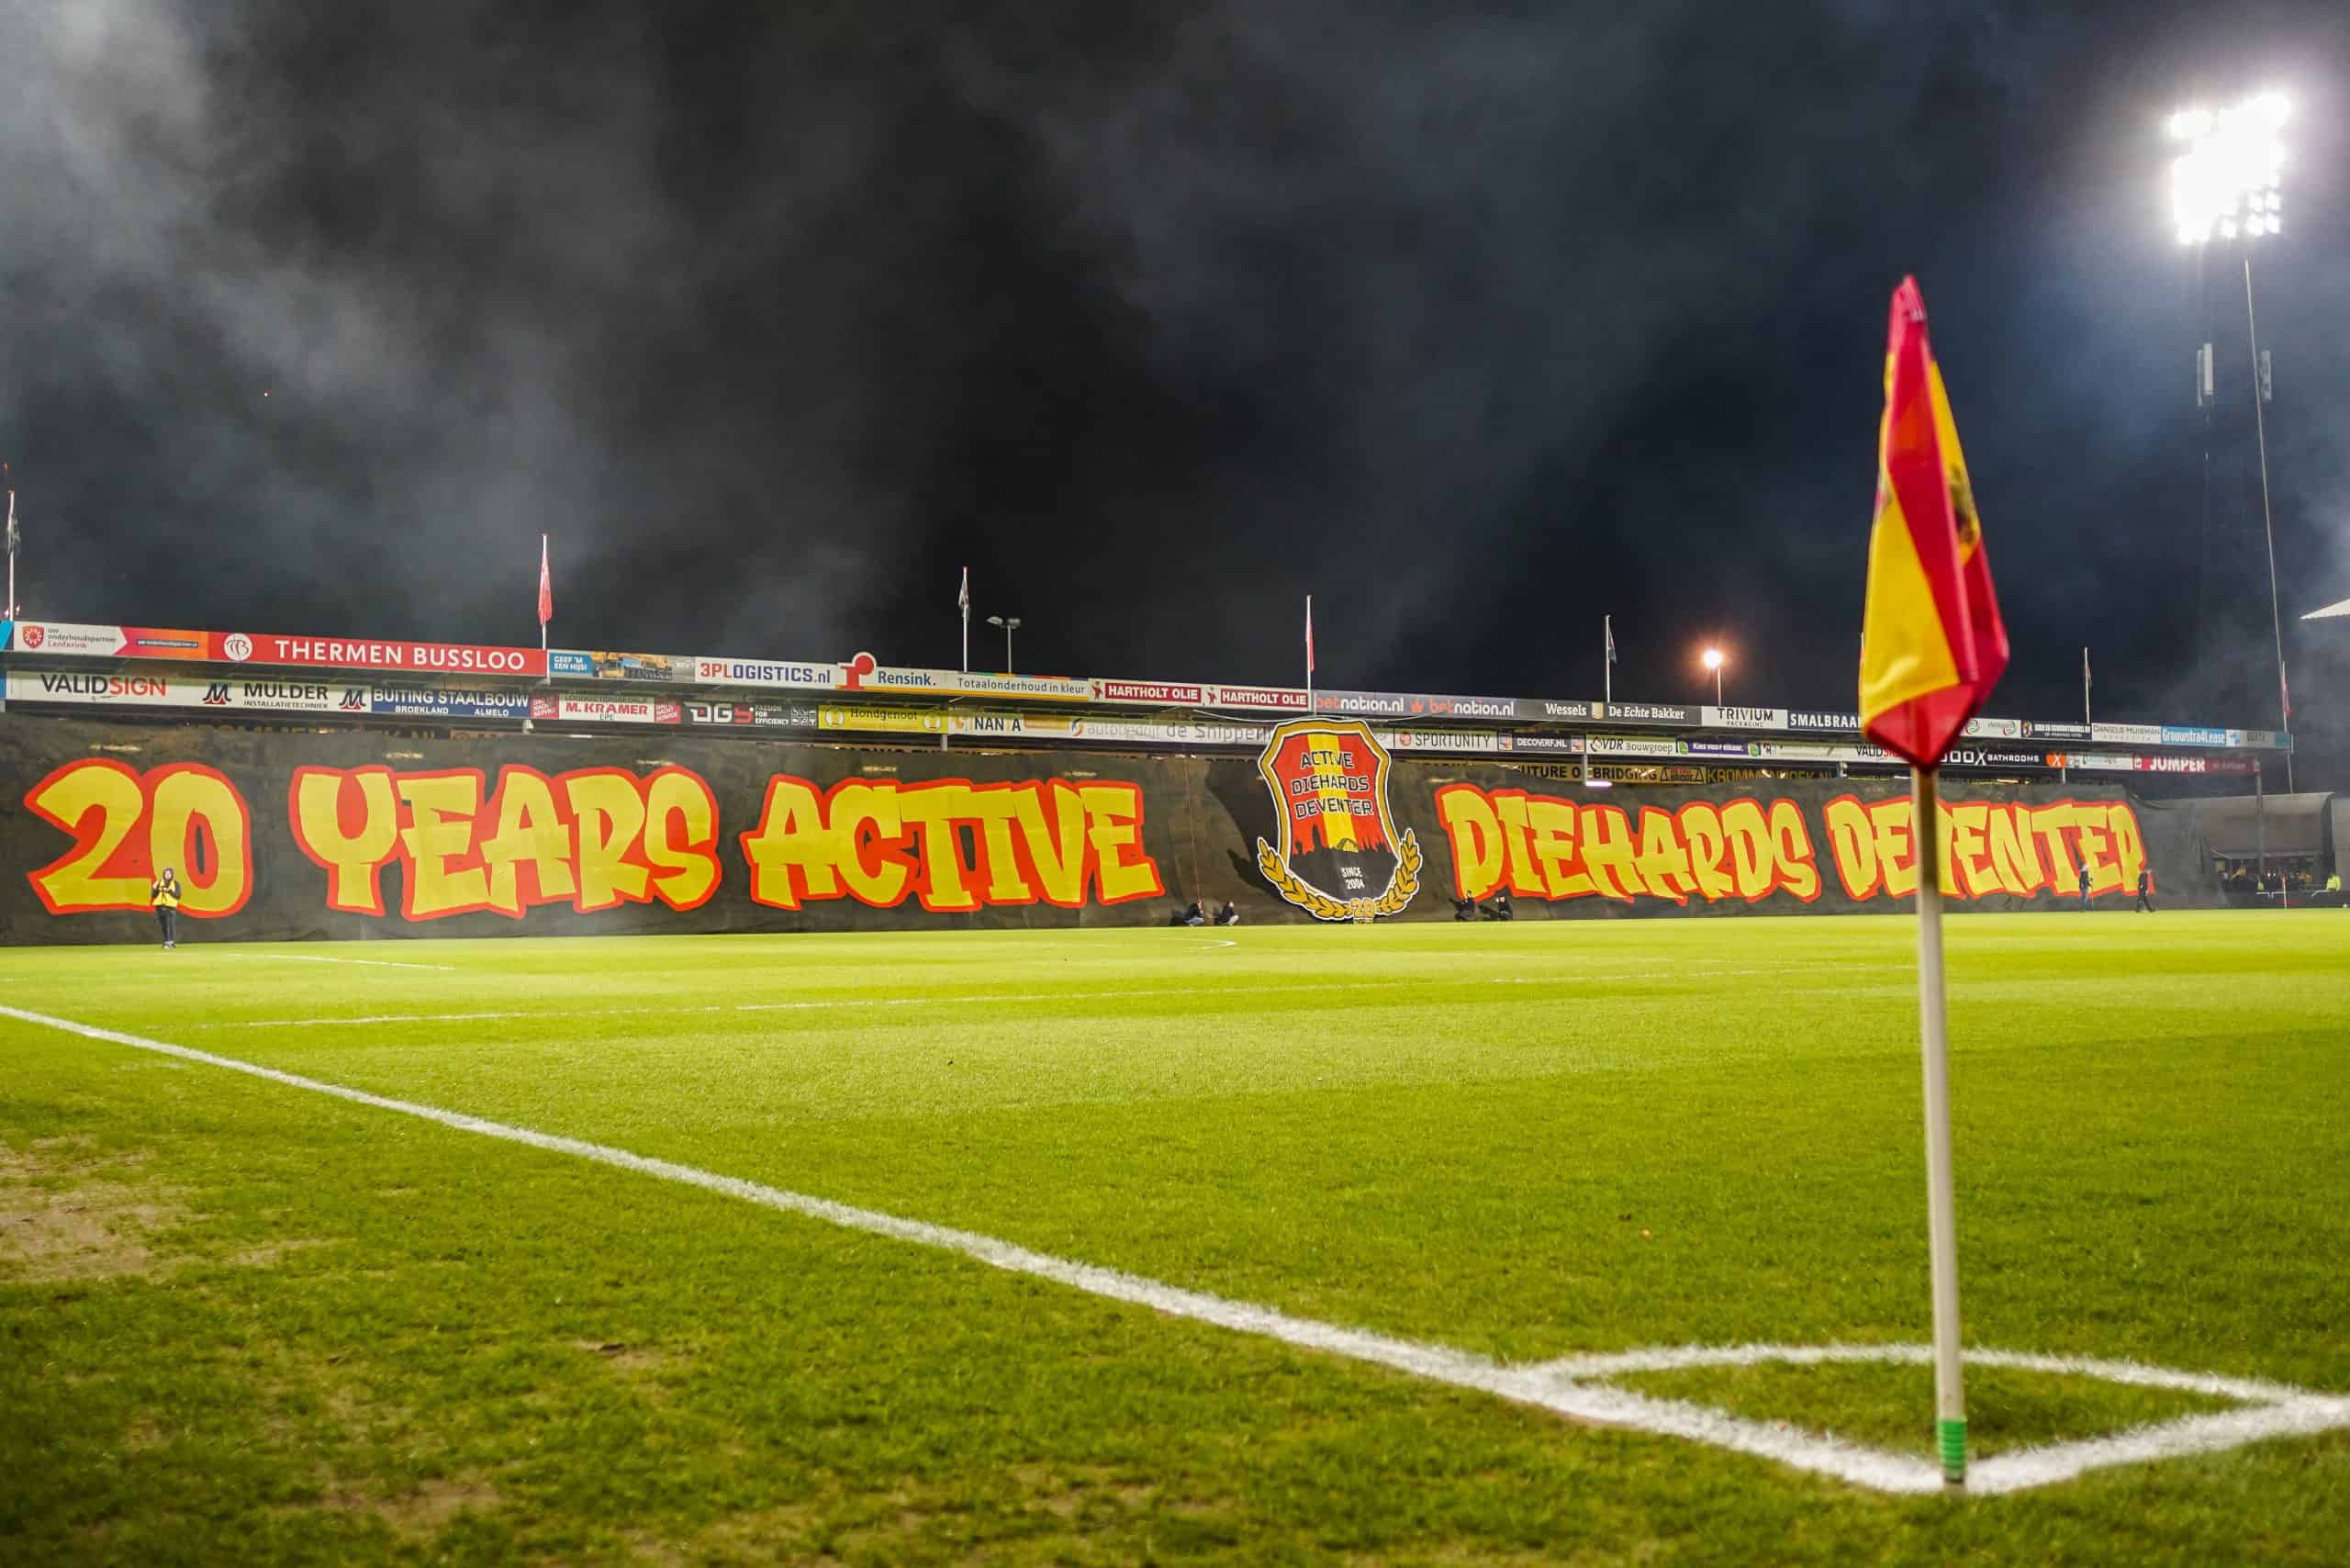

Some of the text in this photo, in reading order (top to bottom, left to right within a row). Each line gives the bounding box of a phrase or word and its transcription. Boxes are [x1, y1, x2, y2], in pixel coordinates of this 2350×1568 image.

[274, 640, 525, 670] THERMEN BUSSLOO
[700, 662, 831, 684] 3PLOGISTICS.nl
[40, 674, 166, 696] VALIDSIGN
[243, 683, 329, 700] MULDER
[957, 678, 1047, 692] Totaalonderhoud
[1049, 682, 1058, 692] in
[1108, 685, 1198, 700] HARTHOLT OLIE
[374, 689, 434, 704] BUITING
[438, 691, 530, 708] STAALBOUW
[1222, 690, 1307, 706] HARTHOLT OLIE
[1315, 692, 1404, 711] betnation.nl
[395, 705, 449, 715] BROEKLAND
[474, 709, 509, 717] ALMELO
[565, 702, 582, 713] M.
[584, 703, 648, 715] KRAMER
[1429, 698, 1515, 716] betnation.nl
[1545, 703, 1587, 716] Wessels
[1608, 706, 1685, 720] De Echte Bakker
[1718, 708, 1774, 722] TRIVIUM
[1166, 722, 1188, 738] de
[1416, 734, 1491, 748] SPORTUNITY
[1602, 738, 1673, 755] VDR Bouwgroep
[1855, 745, 1898, 758] VALIDSI
[1987, 753, 2040, 763] BATHROOMS
[1300, 750, 1354, 770] ACTIVE
[2150, 756, 2206, 772] JUMPER
[1519, 766, 1568, 779] UTURE
[1291, 774, 1370, 796] DIEHARDS
[1294, 798, 1374, 819] DEVENTER
[24, 757, 1165, 922] 20 YEARS ACTIVE
[1435, 783, 1821, 904] DIEHARDS
[1340, 866, 1363, 878] SINCE
[1345, 878, 1366, 890] 2004
